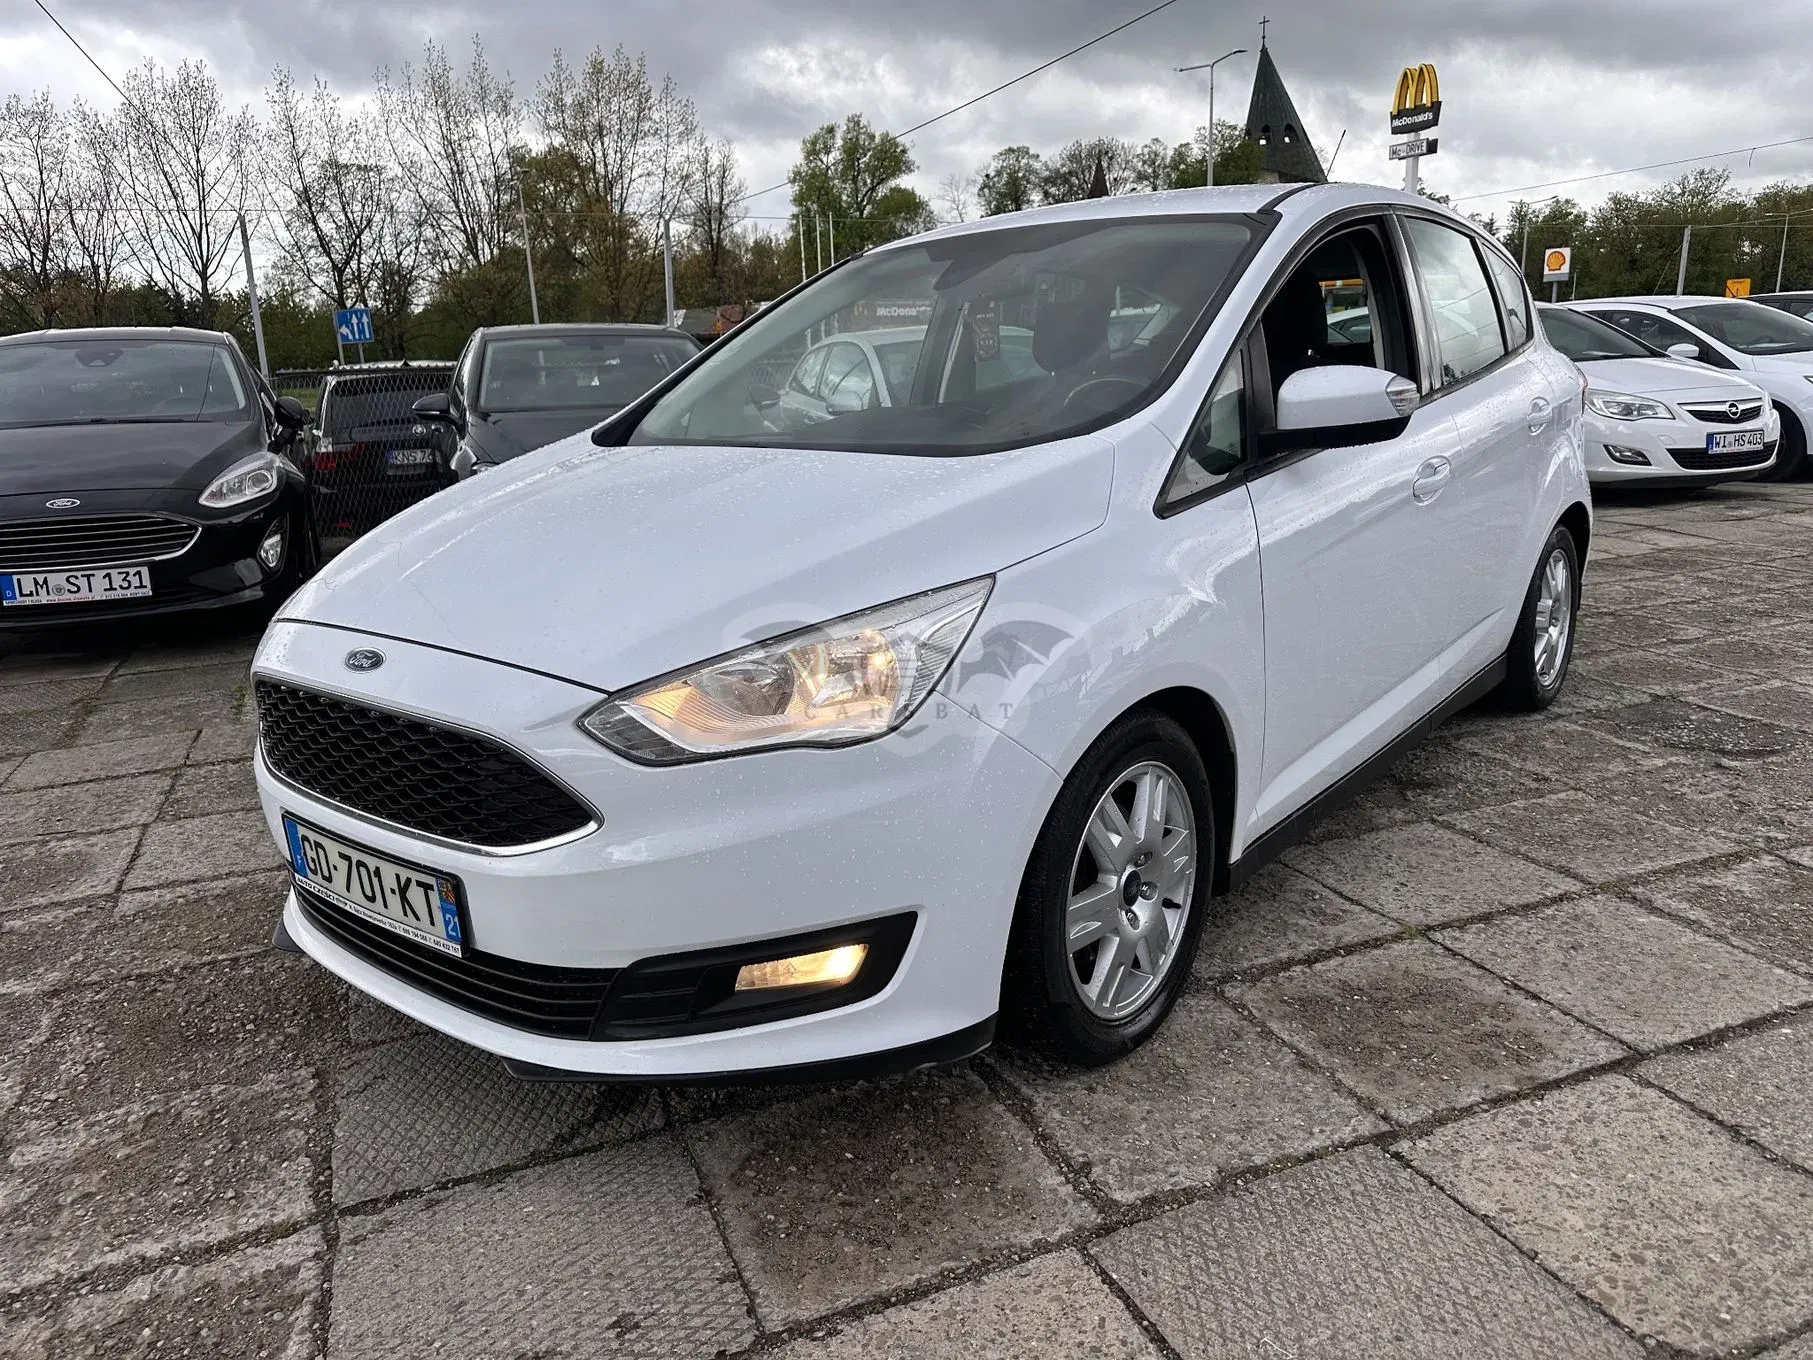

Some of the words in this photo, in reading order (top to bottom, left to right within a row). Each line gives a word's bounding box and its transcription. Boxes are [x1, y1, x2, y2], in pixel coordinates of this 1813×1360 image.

[1391, 112, 1434, 127] McDonald's
[1714, 435, 1727, 449] WI
[1734, 434, 1746, 447] HS
[1747, 433, 1762, 446] 403
[16, 575, 51, 598] LM
[65, 573, 96, 594] ST
[102, 569, 148, 592] 131
[349, 651, 377, 668] Ford
[301, 834, 436, 927] GD-701-KT
